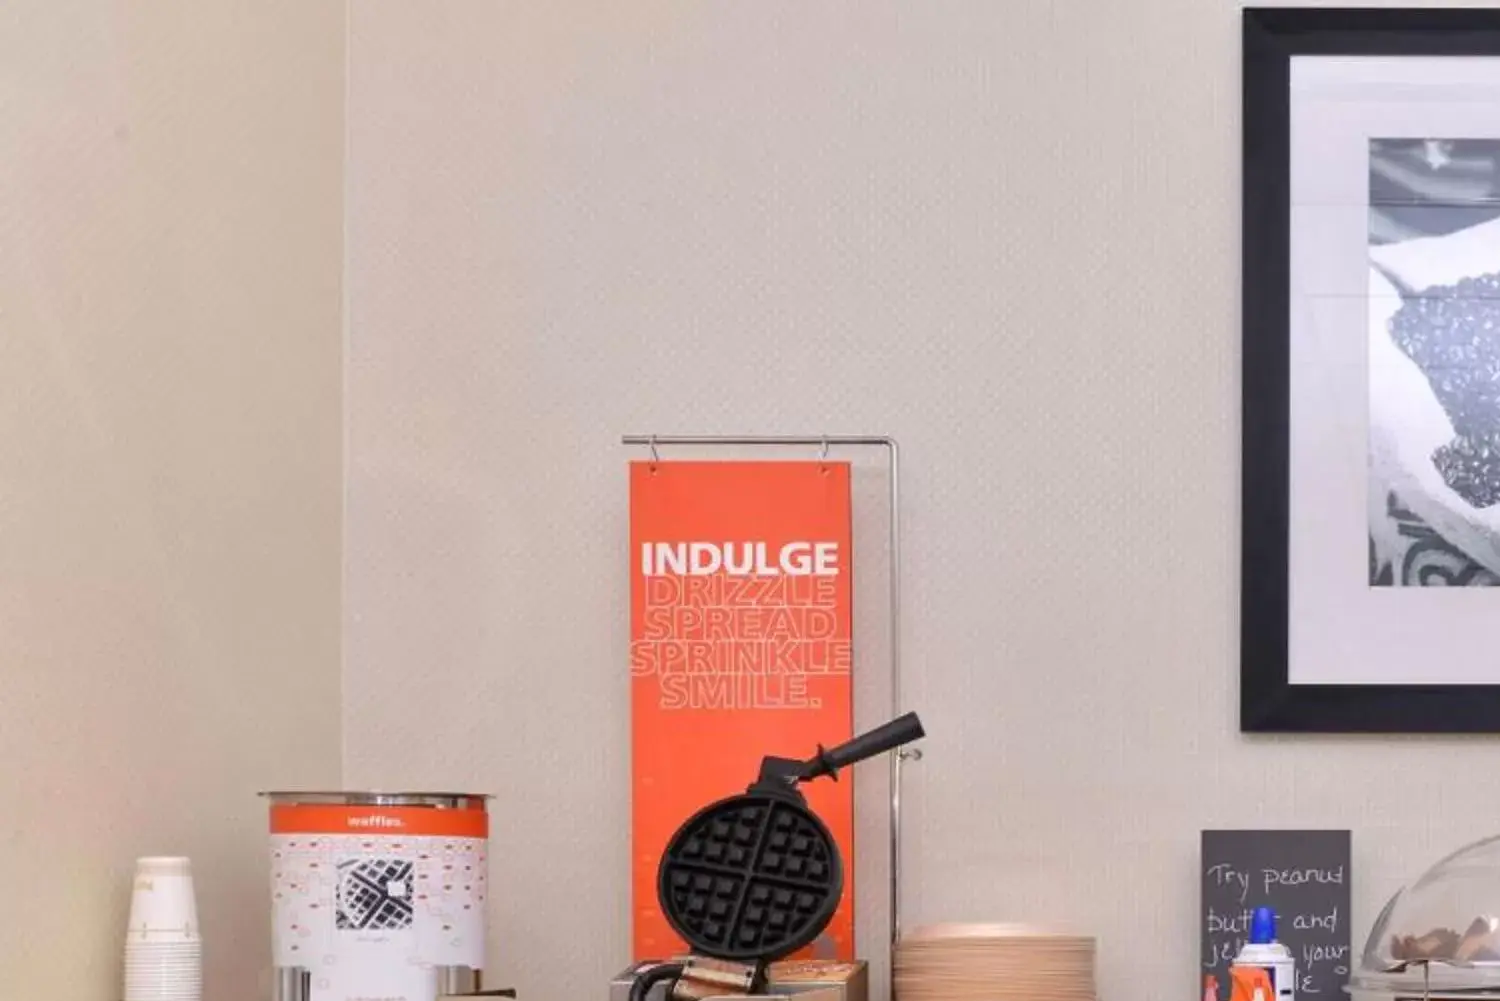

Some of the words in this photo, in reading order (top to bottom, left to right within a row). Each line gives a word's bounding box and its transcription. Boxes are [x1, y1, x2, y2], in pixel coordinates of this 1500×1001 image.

[641, 542, 839, 576] INDULGE
[646, 574, 837, 607] DRIZZLE
[644, 606, 837, 641] SPREAD
[630, 640, 852, 675] SPRINKLE
[660, 673, 823, 709] SMILE.
[1207, 863, 1250, 903] Try
[1261, 866, 1343, 894] peanut
[1293, 905, 1337, 933] and
[1303, 942, 1349, 969] your
